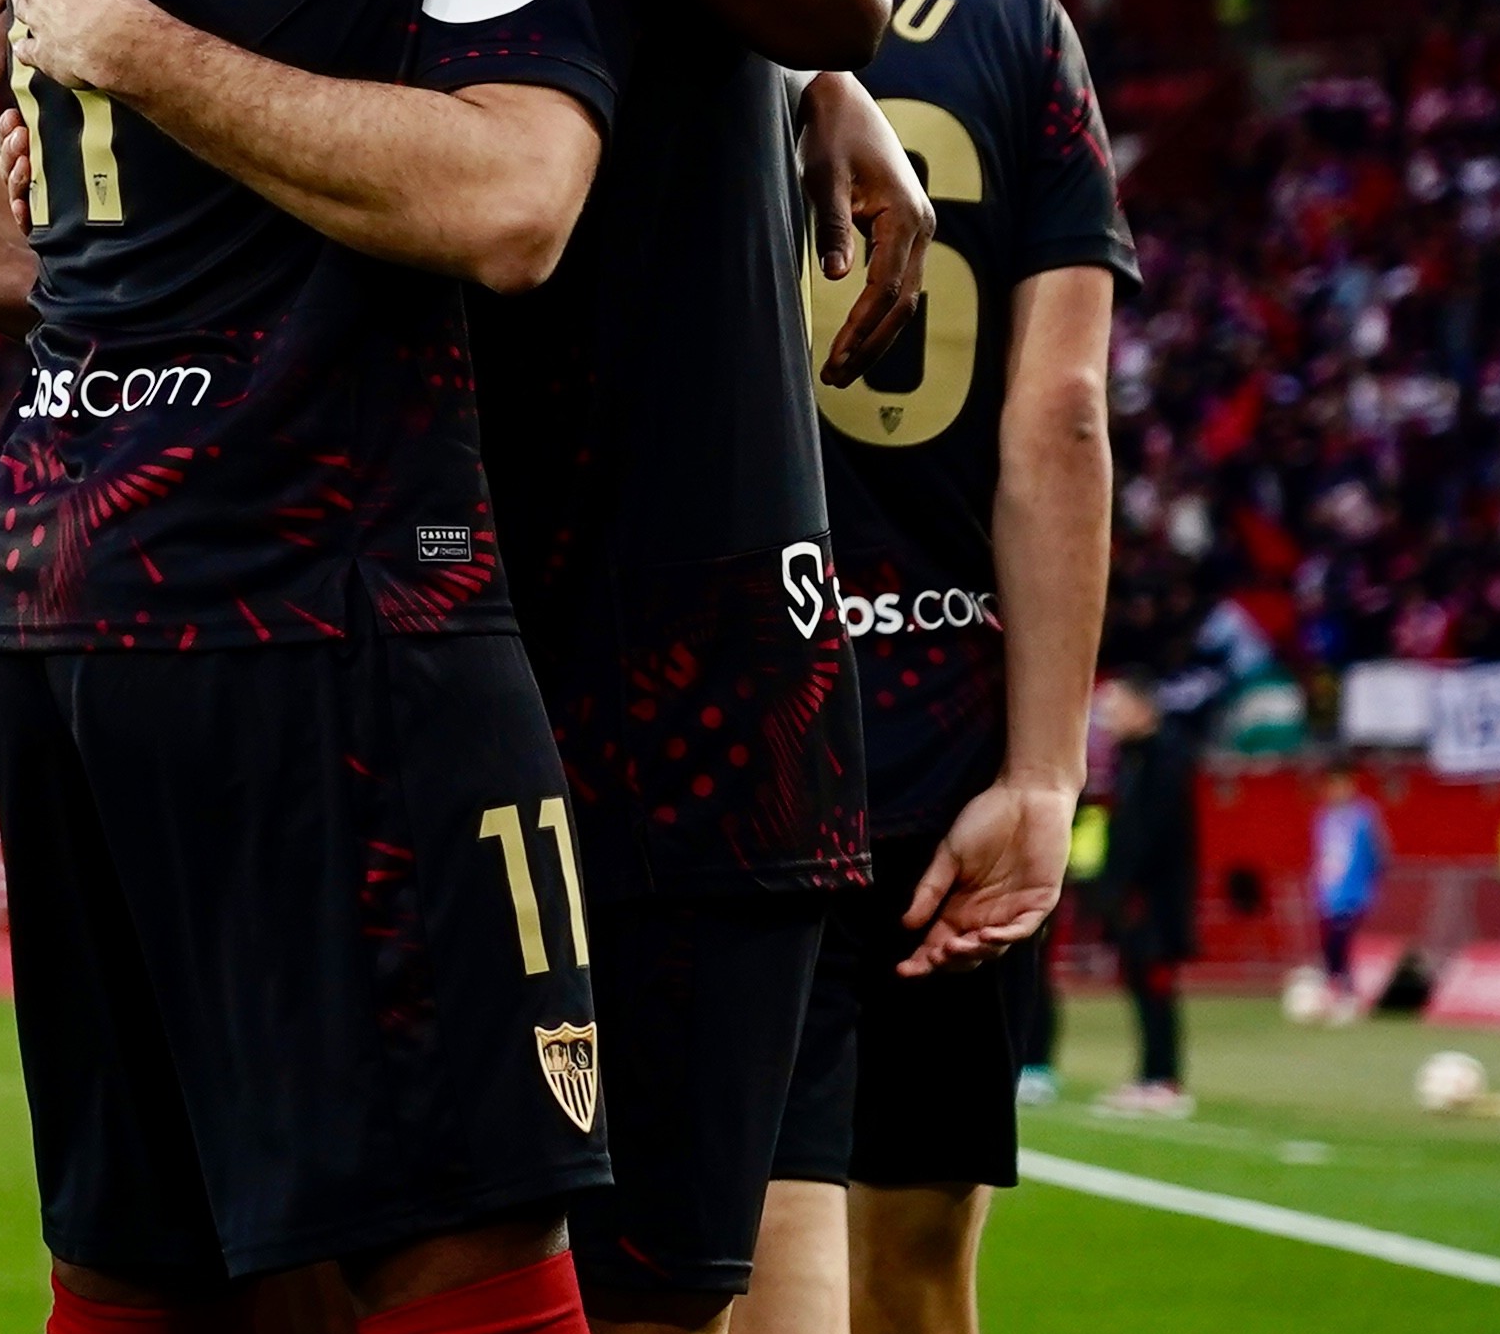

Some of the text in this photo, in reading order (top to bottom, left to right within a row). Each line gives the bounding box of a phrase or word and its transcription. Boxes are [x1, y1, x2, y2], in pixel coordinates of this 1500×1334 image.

[801, 98, 982, 447] 6
[420, 531, 467, 540] CASTORE
[478, 796, 590, 975] 11
